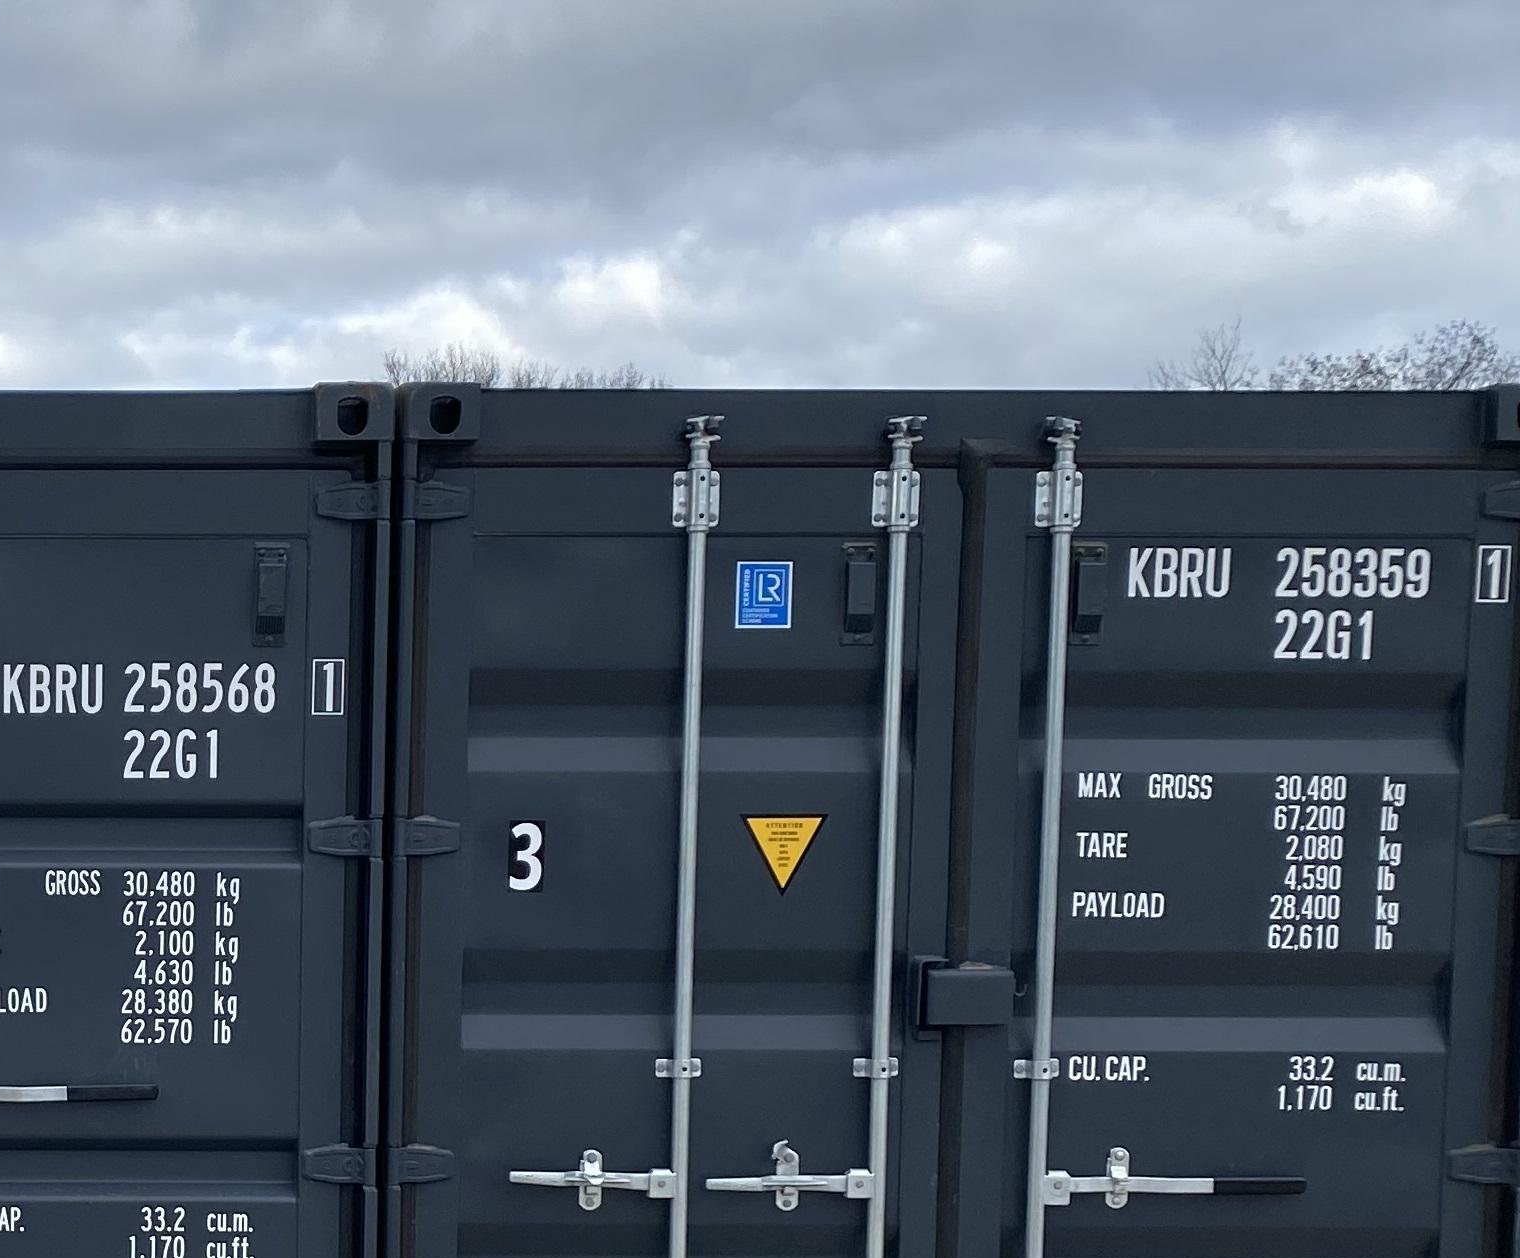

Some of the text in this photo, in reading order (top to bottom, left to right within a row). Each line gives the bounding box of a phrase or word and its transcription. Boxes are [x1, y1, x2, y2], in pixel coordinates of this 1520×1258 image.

[758, 573, 782, 602] LR
[1127, 547, 1502, 599] KBRU 258359 1
[1273, 609, 1373, 660] 22G1
[3, 662, 335, 714] KBRU 258568 1
[123, 728, 218, 779] 22G1
[1078, 772, 1122, 799] MAX
[1148, 773, 1213, 800] GROSS
[1382, 776, 1406, 807] kg
[1380, 806, 1399, 832] lb
[509, 822, 542, 891] 3
[1076, 832, 1129, 858] TARE
[1378, 835, 1402, 867] kg
[45, 869, 101, 896] GROSS
[216, 871, 240, 905] kg
[1376, 865, 1395, 891] lb
[215, 901, 234, 927] lb
[1071, 891, 1165, 918] PAYLOAD
[1376, 895, 1399, 926] kg
[215, 930, 239, 964] kg
[1374, 924, 1393, 950] lb
[214, 960, 232, 986] lb
[214, 989, 238, 1023] kg
[213, 1019, 231, 1044] lb
[1289, 1055, 1334, 1081] 33.2
[1356, 1062, 1406, 1082] cu.m.
[1354, 1086, 1404, 1111] cu.ft.
[140, 1206, 186, 1232] 33.2
[206, 1213, 254, 1233] cu.m.
